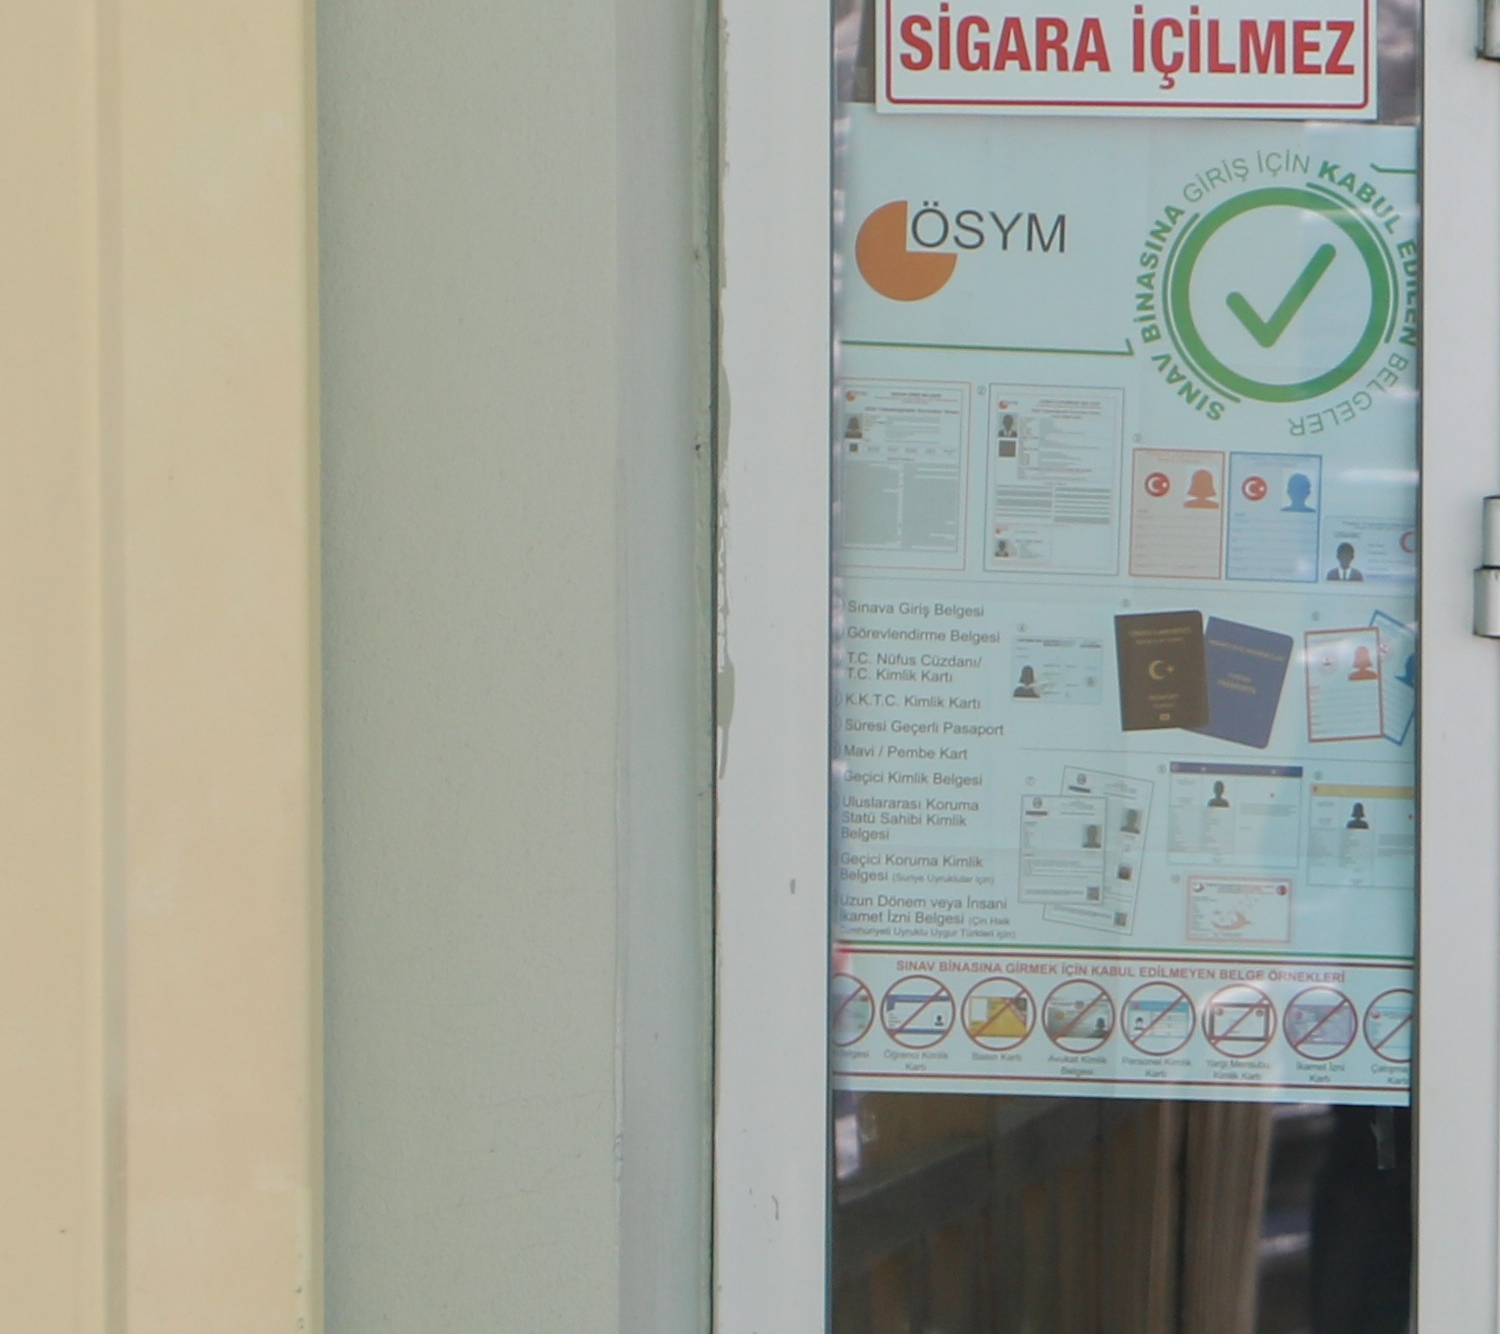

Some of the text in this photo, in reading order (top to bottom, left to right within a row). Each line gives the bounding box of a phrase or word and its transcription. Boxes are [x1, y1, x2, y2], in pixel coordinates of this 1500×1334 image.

[899, 1, 1355, 89] SİGARA İÇİLMEZ
[1257, 149, 1310, 176] İÇİN
[1183, 157, 1249, 203] GİRİŞ
[1317, 160, 1402, 234] KABUL
[910, 200, 1066, 253] ÖSYM
[1133, 204, 1185, 343] BİNASINA
[1151, 352, 1225, 421] SINAV
[1287, 352, 1408, 437] BELGELER
[848, 600, 985, 619] Sınava Giriş Belgesi
[847, 626, 1000, 645] Görevlendirme Belgesi
[877, 652, 917, 667] Nüfus
[876, 669, 916, 681] Kimlik
[921, 670, 953, 683] Kartı
[904, 695, 945, 708] Kimlik
[949, 697, 981, 710] Kartı
[845, 718, 1004, 737] Süresi Geçerli Pasaport
[844, 745, 874, 757] Mavi
[887, 746, 935, 759] Pembe
[940, 748, 968, 760] Kart
[888, 772, 928, 784] Kimlik
[933, 773, 983, 788] Belgesi
[842, 796, 979, 811] Uluslararası Koruma
[842, 812, 967, 826] Statü Sahibi Kimlik
[841, 828, 889, 842] Belgesi
[840, 852, 984, 867] Geçici Koruma Kimlik
[840, 869, 888, 883] Belgesi
[840, 894, 1007, 911] Uzun Dönem veya İnsani
[915, 912, 964, 926] Belgesi
[896, 959, 1345, 983] SINAV BİNASINA GİRMEK İÇİN KABUL EDİLMEYEN BELGE ÖRNEKLERİ
